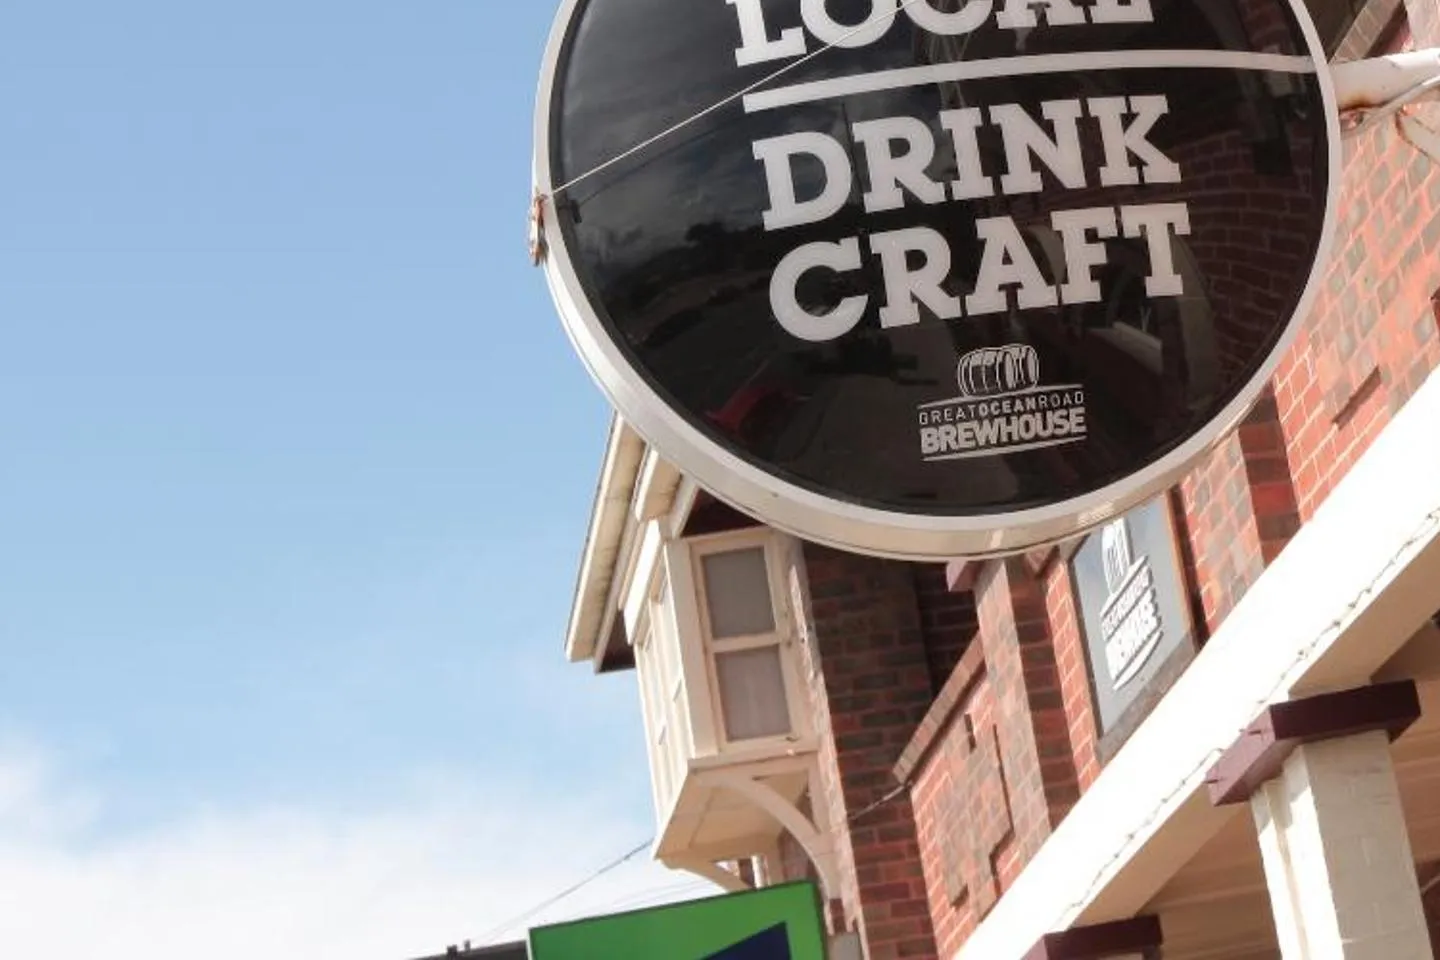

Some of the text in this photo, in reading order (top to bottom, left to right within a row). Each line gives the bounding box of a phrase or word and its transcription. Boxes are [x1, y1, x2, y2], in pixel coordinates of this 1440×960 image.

[751, 94, 1183, 232] DRINK
[768, 202, 1191, 343] CRAFT
[919, 406, 1088, 455] BREWHOUSE
